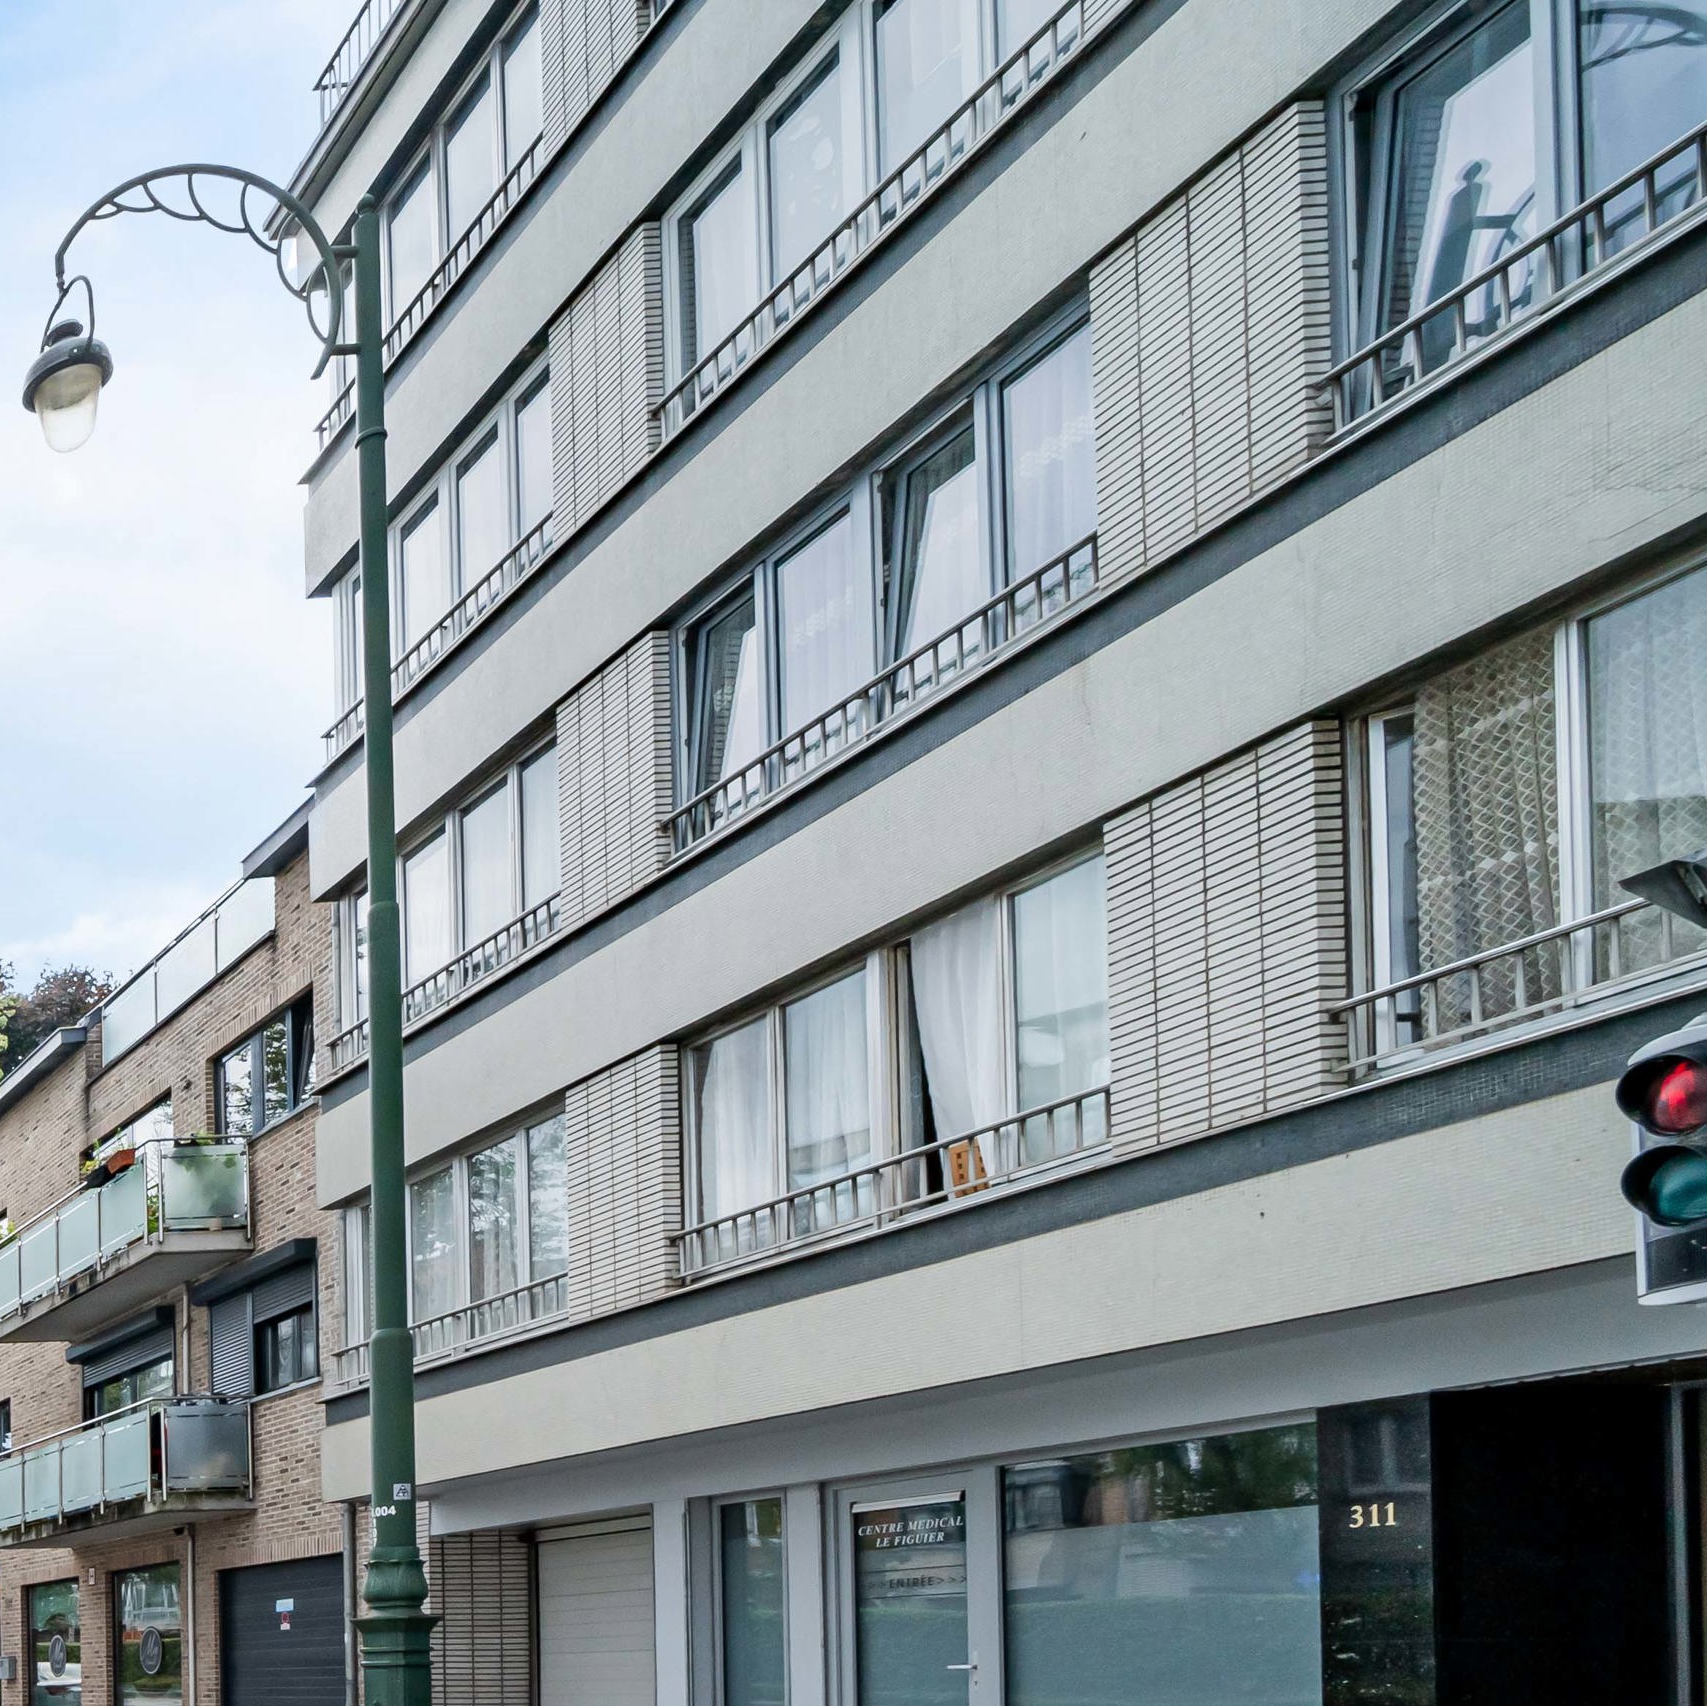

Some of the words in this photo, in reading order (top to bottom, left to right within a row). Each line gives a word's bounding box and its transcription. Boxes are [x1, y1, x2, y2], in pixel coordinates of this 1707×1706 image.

[1349, 1502, 1396, 1528] 311
[858, 1522, 904, 1536] CENTRE
[908, 1516, 963, 1531] MEDICAL
[876, 1538, 890, 1548] LE
[894, 1532, 944, 1546] FIGUIER
